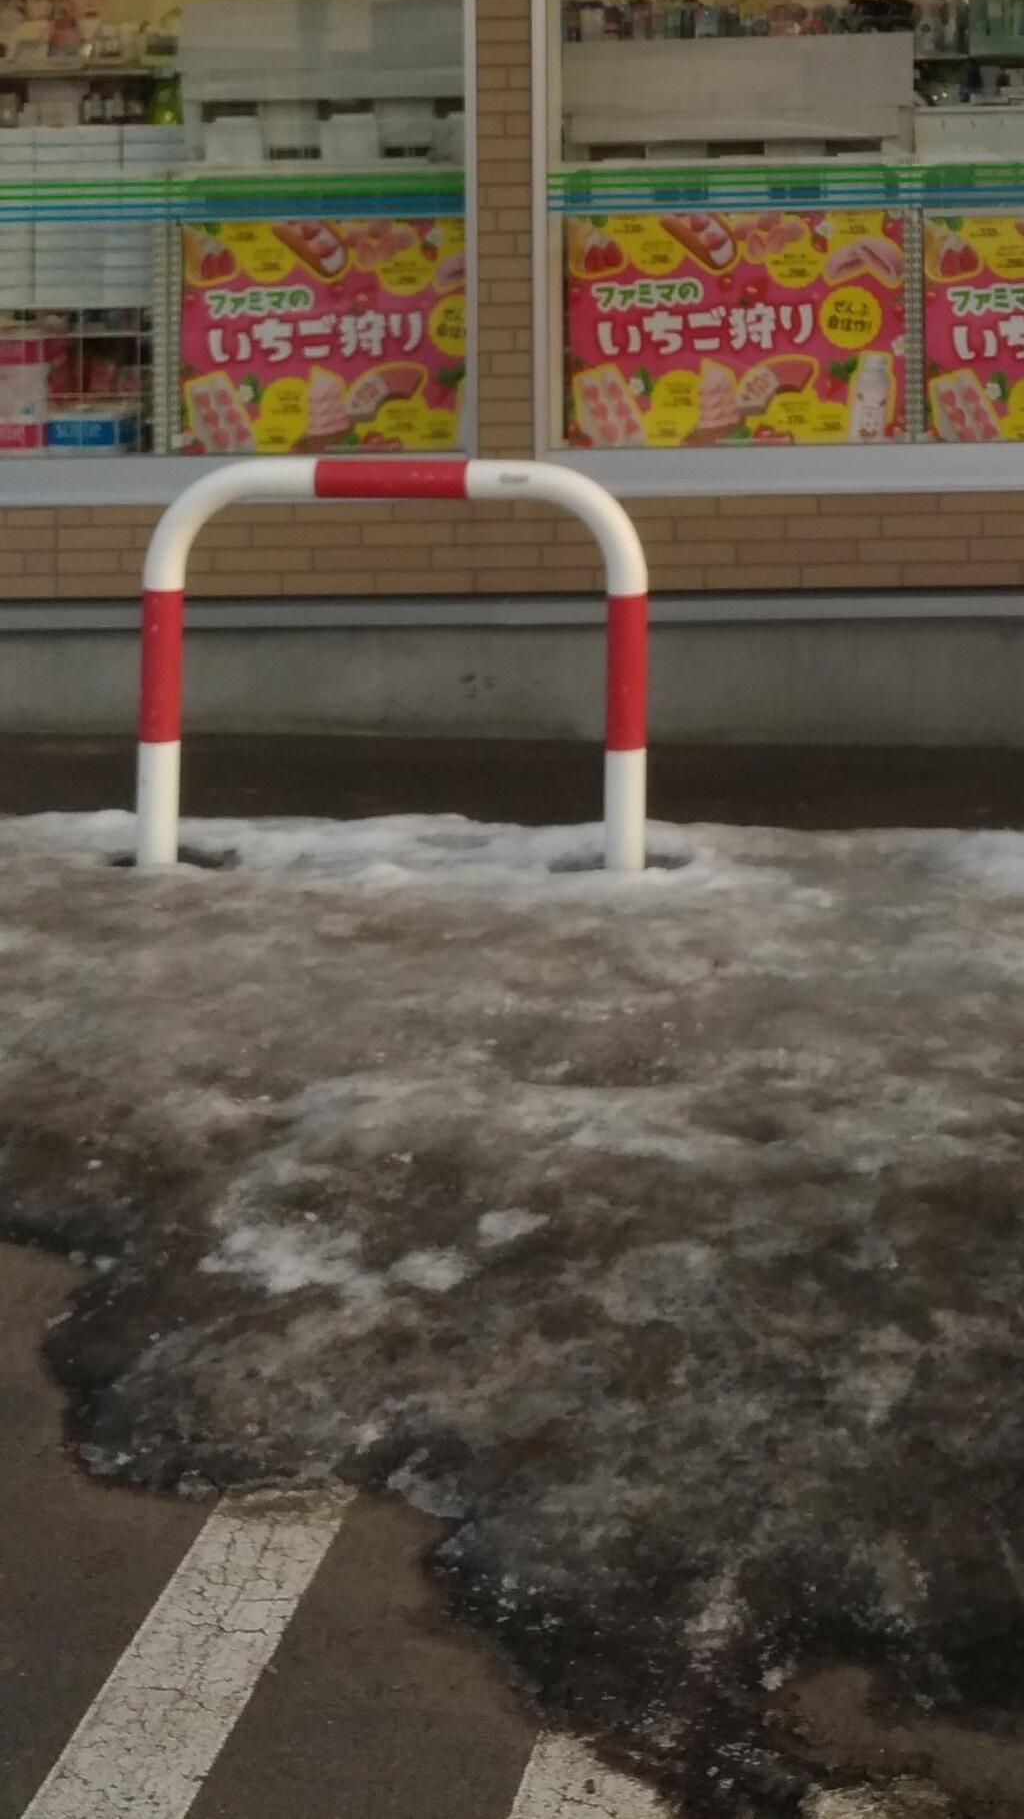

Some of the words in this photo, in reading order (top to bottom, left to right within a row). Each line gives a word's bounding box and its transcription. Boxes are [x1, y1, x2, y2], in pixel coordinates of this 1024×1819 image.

[207, 289, 310, 314] ファミマの
[595, 281, 699, 308] ファミマの
[208, 310, 423, 363] いちご狩り
[596, 301, 814, 356] いちご狩り
